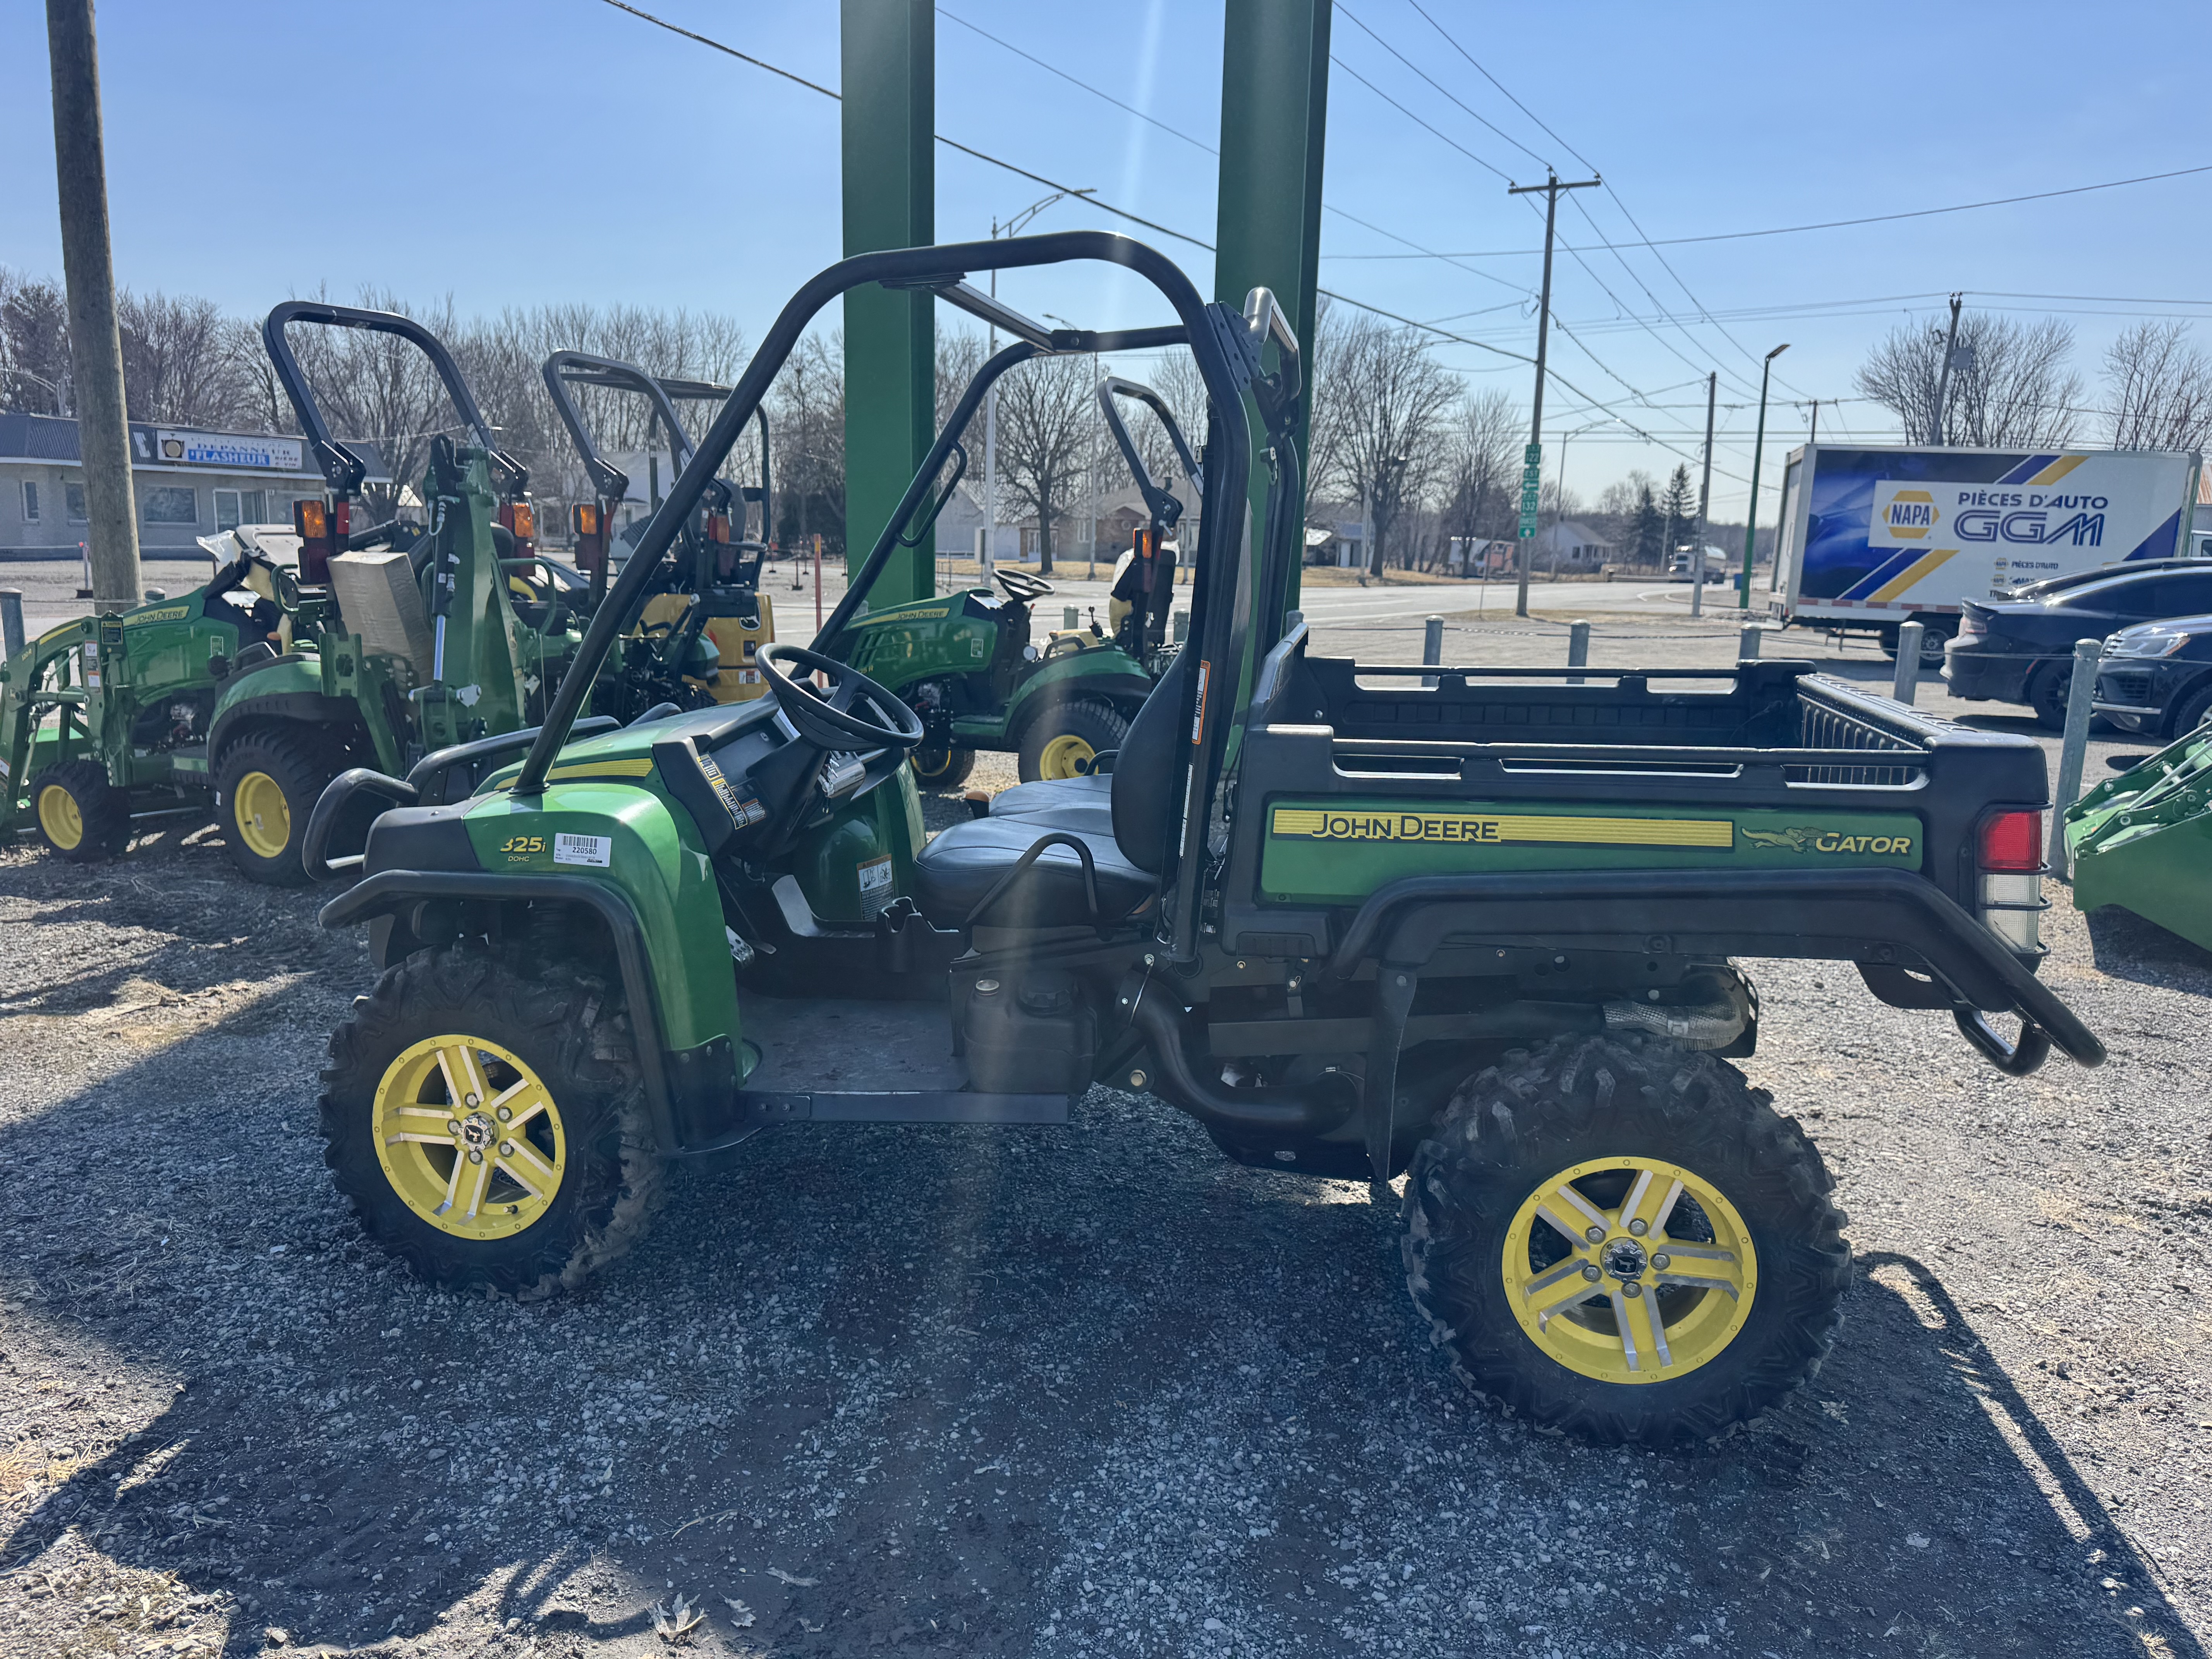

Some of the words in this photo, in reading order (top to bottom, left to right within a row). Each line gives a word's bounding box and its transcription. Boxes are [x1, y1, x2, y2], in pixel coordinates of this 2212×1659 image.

[1958, 490, 2022, 507] PIÈCES
[2029, 495, 2108, 509] D'AUTO
[1891, 504, 1930, 526] NAPA
[1954, 510, 2105, 547] GGM
[135, 613, 155, 625] JOHN
[157, 611, 184, 620] DEERE
[898, 611, 917, 620] JOHN
[919, 611, 944, 619] DEERE
[1311, 813, 1392, 838] JOHN
[1400, 815, 1499, 840] DEERE
[572, 847, 597, 855] 220580
[1815, 832, 1911, 854] GATOR
